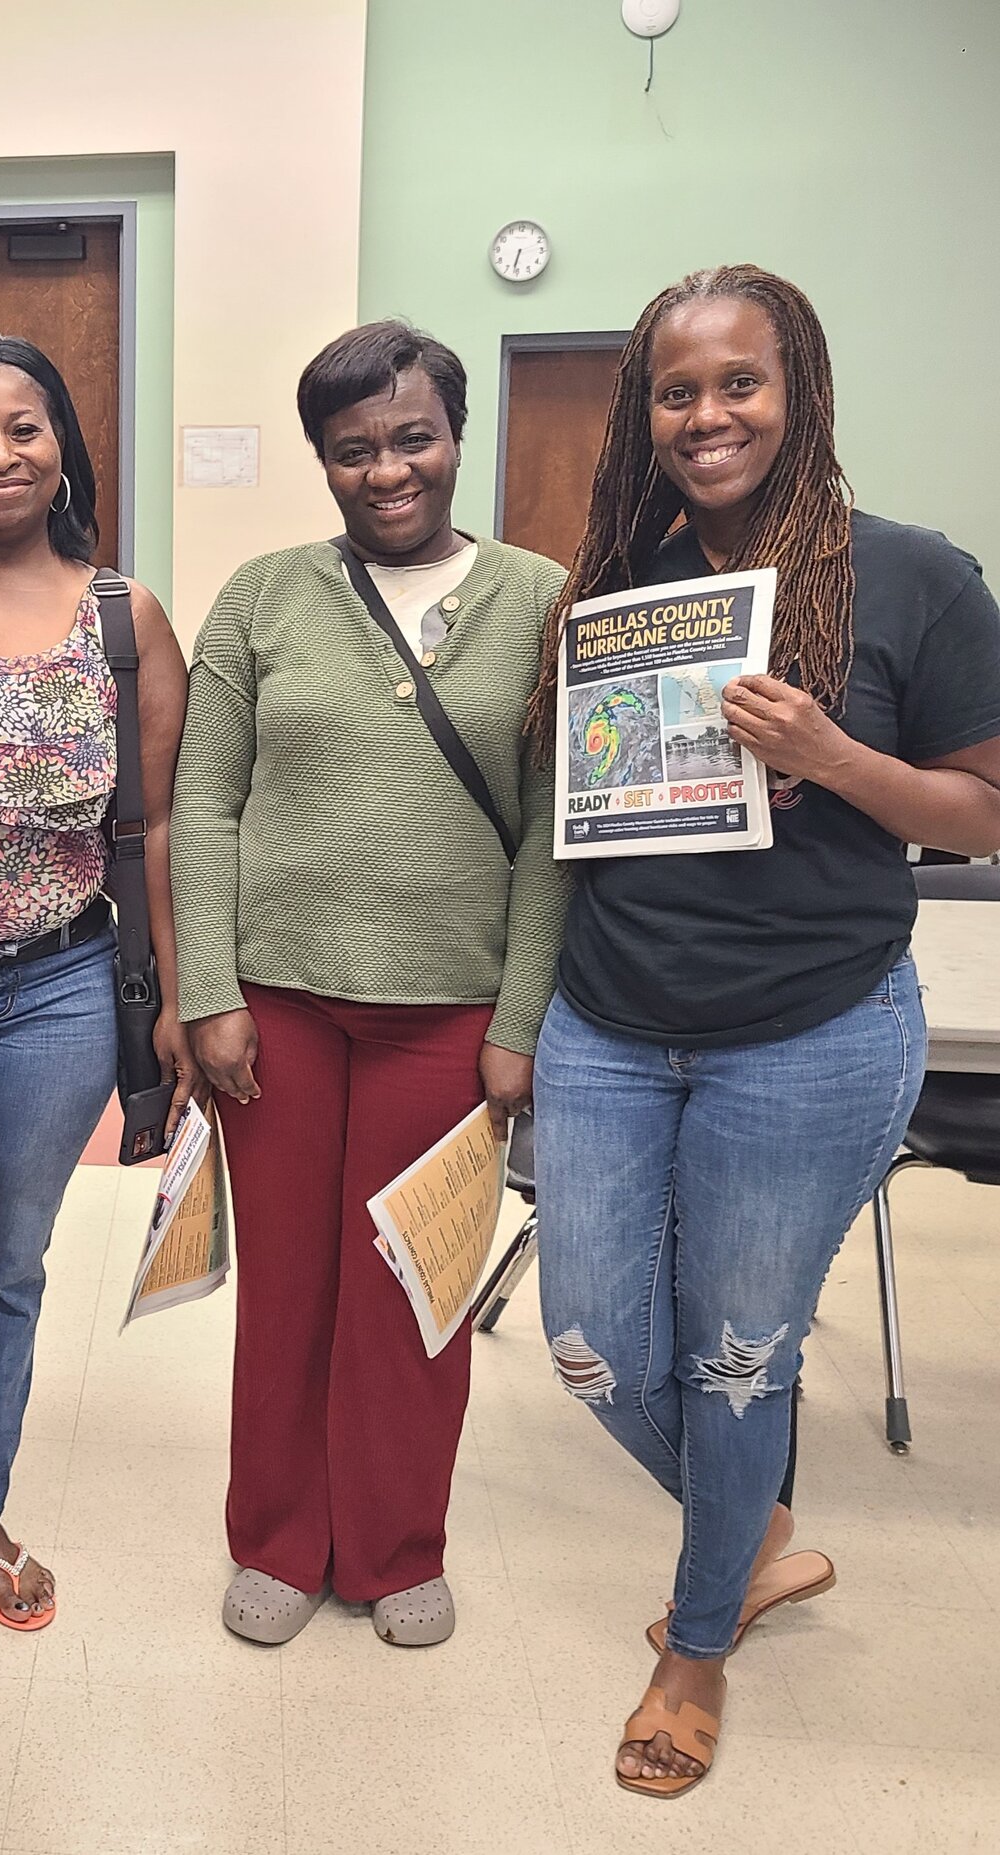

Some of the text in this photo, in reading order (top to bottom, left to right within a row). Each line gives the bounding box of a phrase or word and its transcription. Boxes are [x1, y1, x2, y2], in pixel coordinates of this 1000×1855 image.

[518, 224, 526, 233] 12
[576, 616, 734, 661] HURRICANE GUIDE
[577, 596, 736, 642] PINELLAS COUNTY
[568, 793, 612, 815] READY
[623, 788, 654, 808] SET
[669, 779, 745, 804] PROTECT
